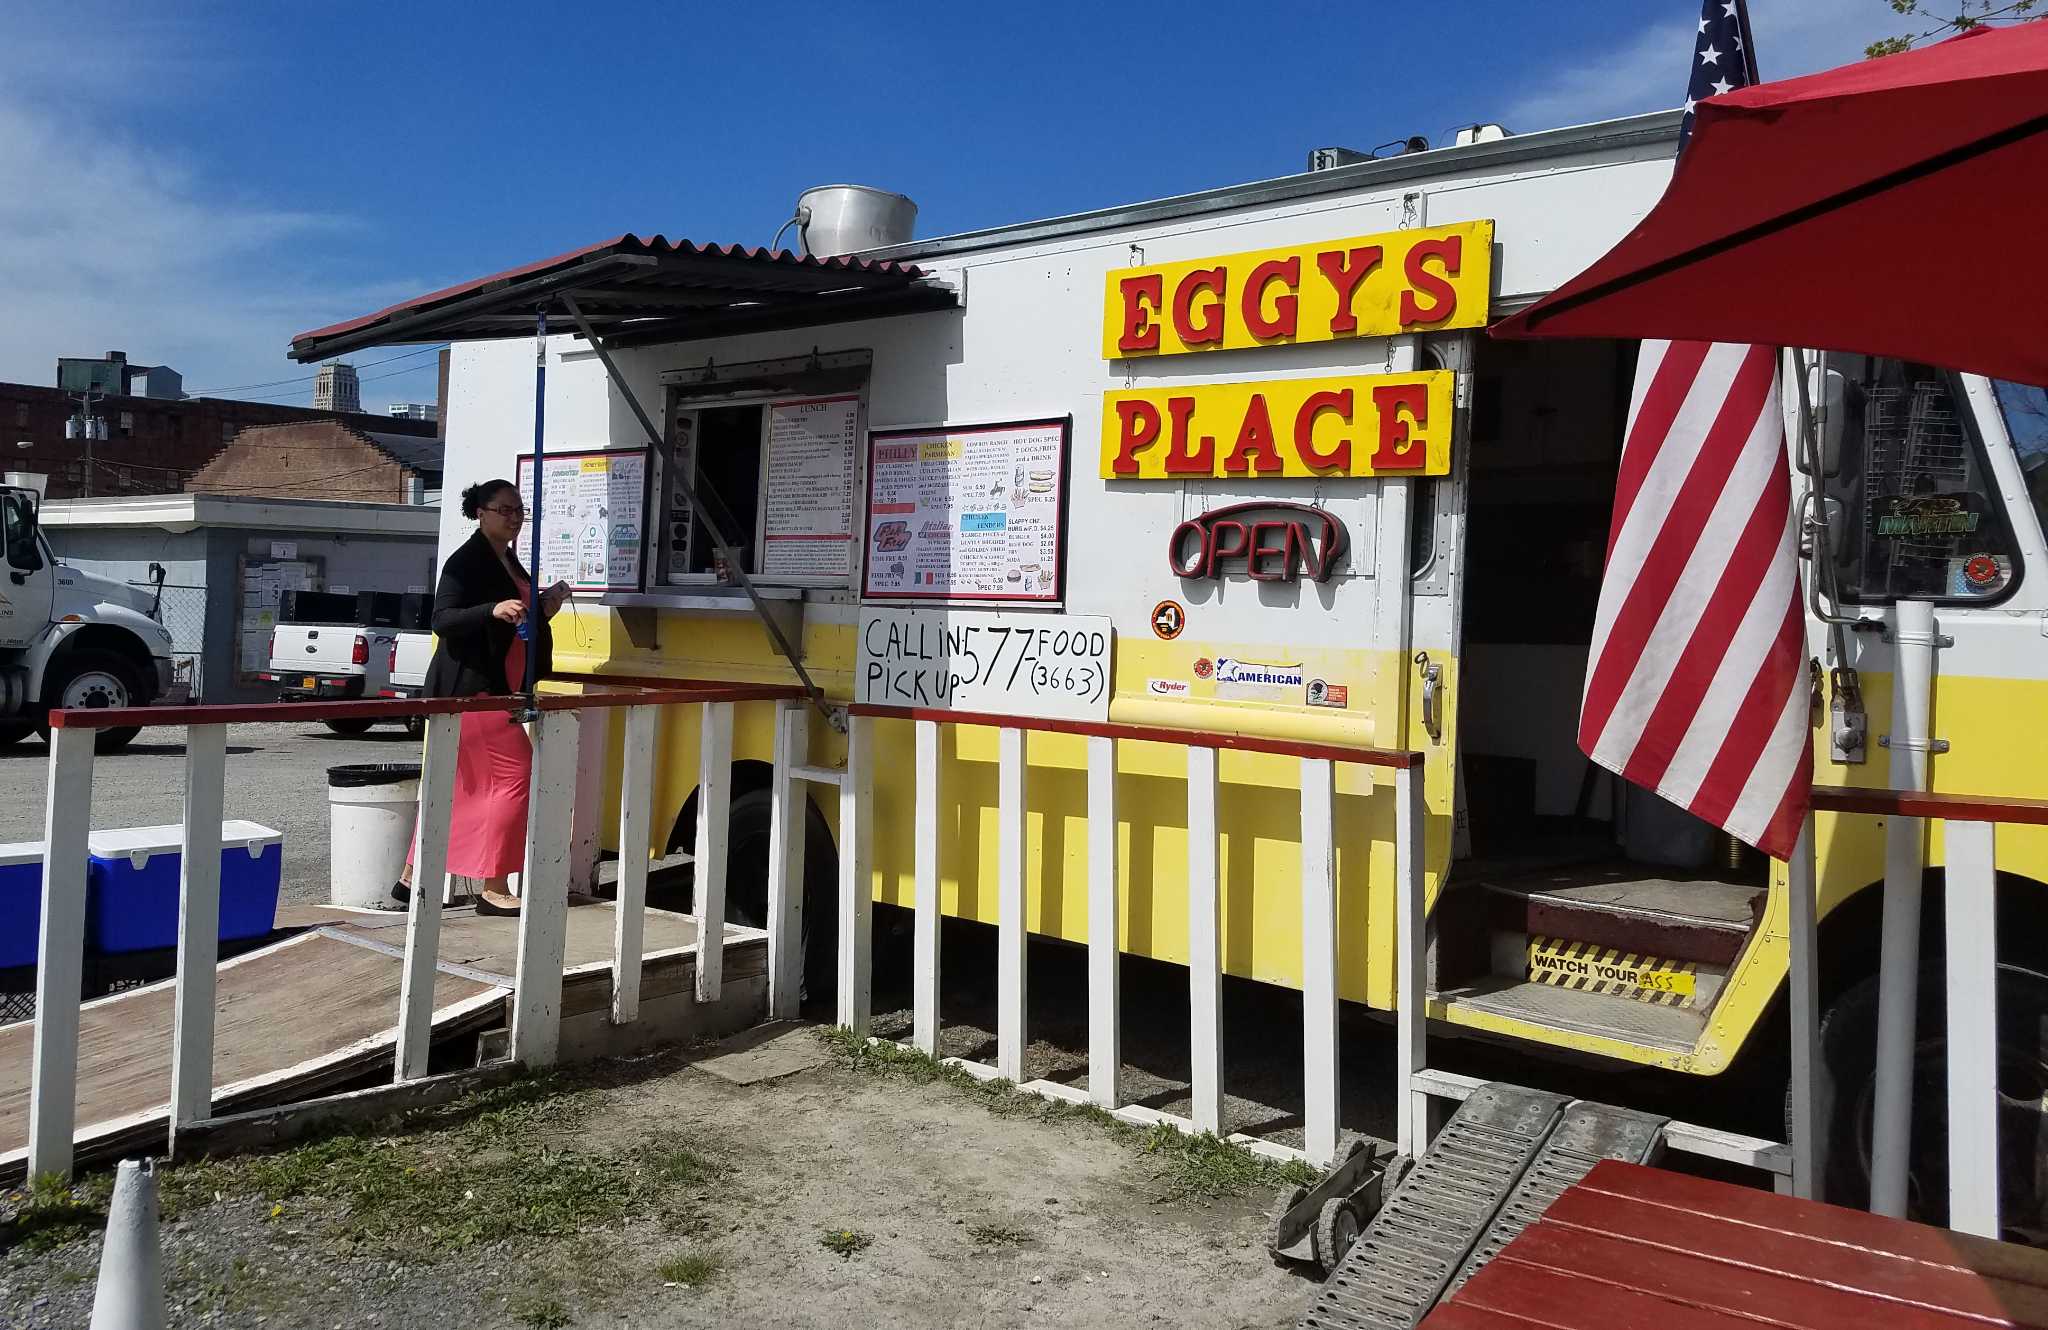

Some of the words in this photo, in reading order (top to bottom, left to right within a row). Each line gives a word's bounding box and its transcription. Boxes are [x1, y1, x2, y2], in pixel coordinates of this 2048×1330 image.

[1118, 235, 1462, 353] EGGYS
[1112, 383, 1430, 475] PLACE
[1169, 509, 1340, 584] OPEN
[865, 618, 932, 660] CALL
[1158, 680, 1188, 692] Ryder
[1237, 672, 1302, 686] AMERICAN
[1533, 954, 1589, 975] WATCH
[1594, 964, 1638, 984] YOUR
